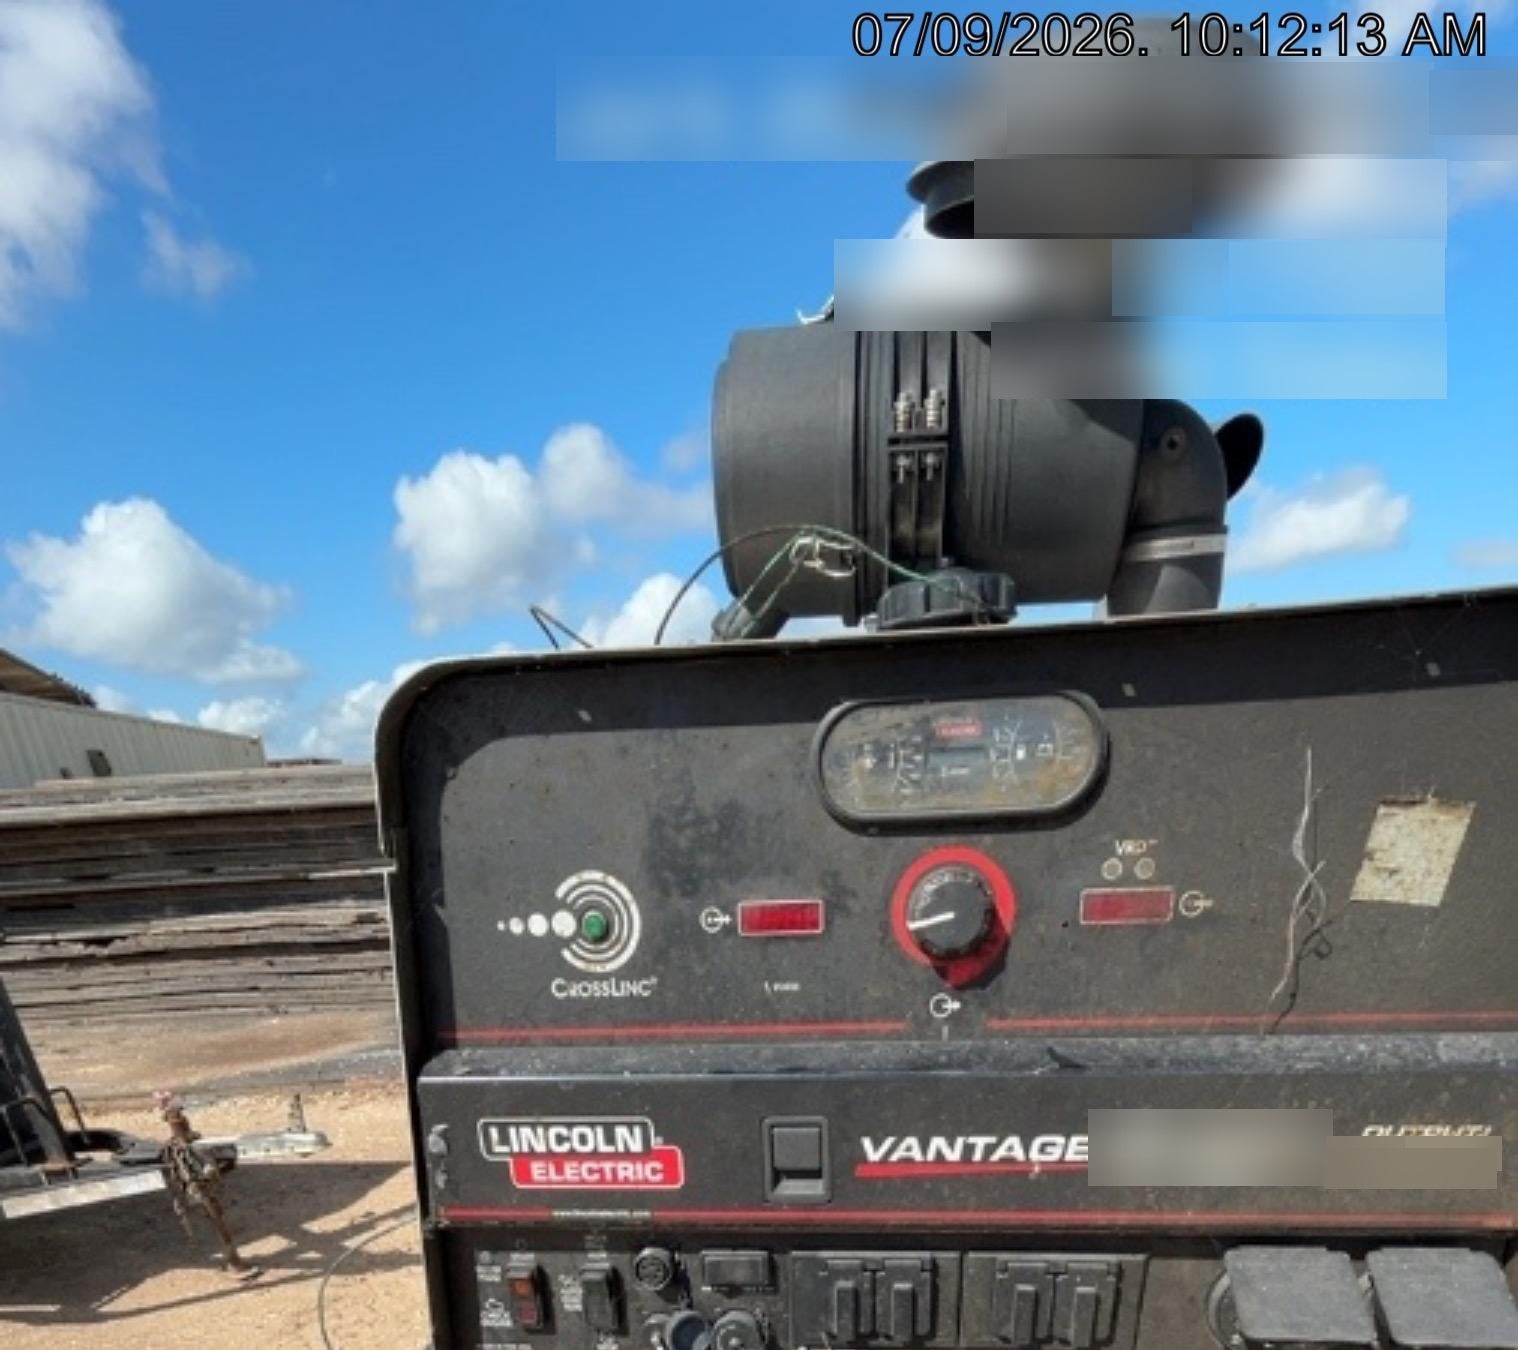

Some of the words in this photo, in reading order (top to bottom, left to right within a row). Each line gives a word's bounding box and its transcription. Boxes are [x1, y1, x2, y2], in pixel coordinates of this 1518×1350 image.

[488, 1124, 643, 1153] LINCOLN
[860, 1134, 1088, 1163] VANTAGE
[529, 1160, 665, 1183] ELECTRIC
